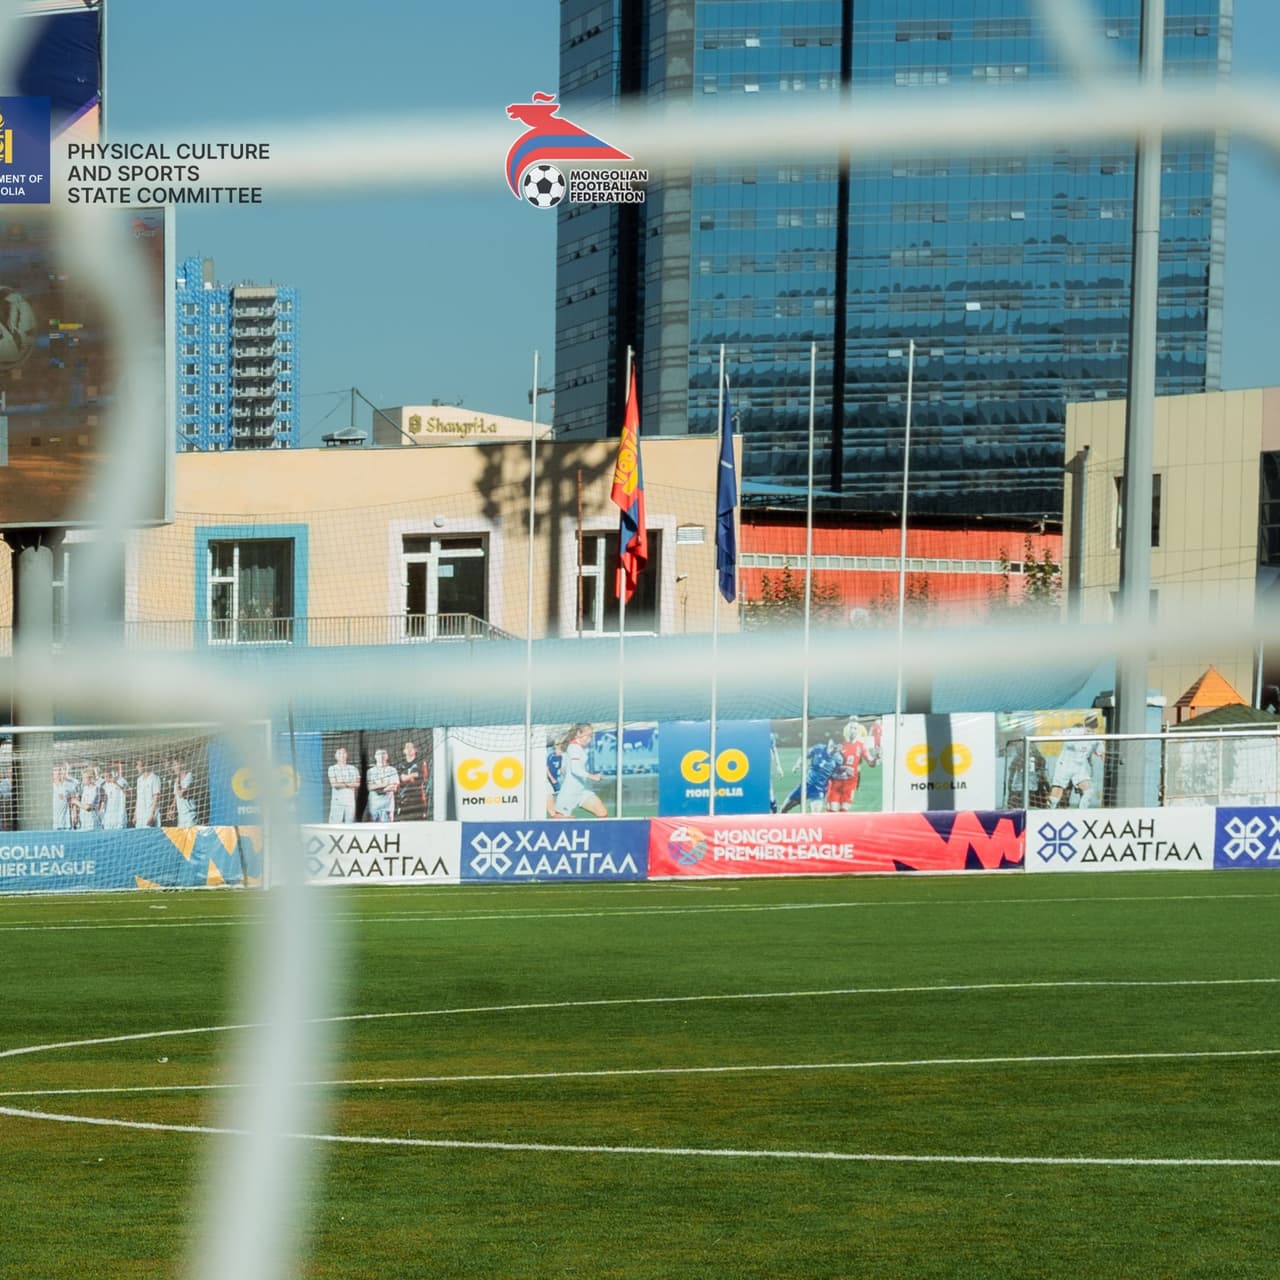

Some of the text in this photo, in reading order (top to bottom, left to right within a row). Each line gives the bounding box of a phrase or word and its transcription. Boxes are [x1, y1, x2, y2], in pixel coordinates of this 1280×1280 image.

[680, 748, 750, 784] GO
[905, 743, 973, 776] GO
[457, 757, 524, 791] GO
[462, 796, 519, 805] MONGOLIA
[714, 827, 823, 844] MONGOLIAN
[714, 844, 855, 862] PREMIER LEAGUE
[30, 860, 96, 877] LEAGUE
